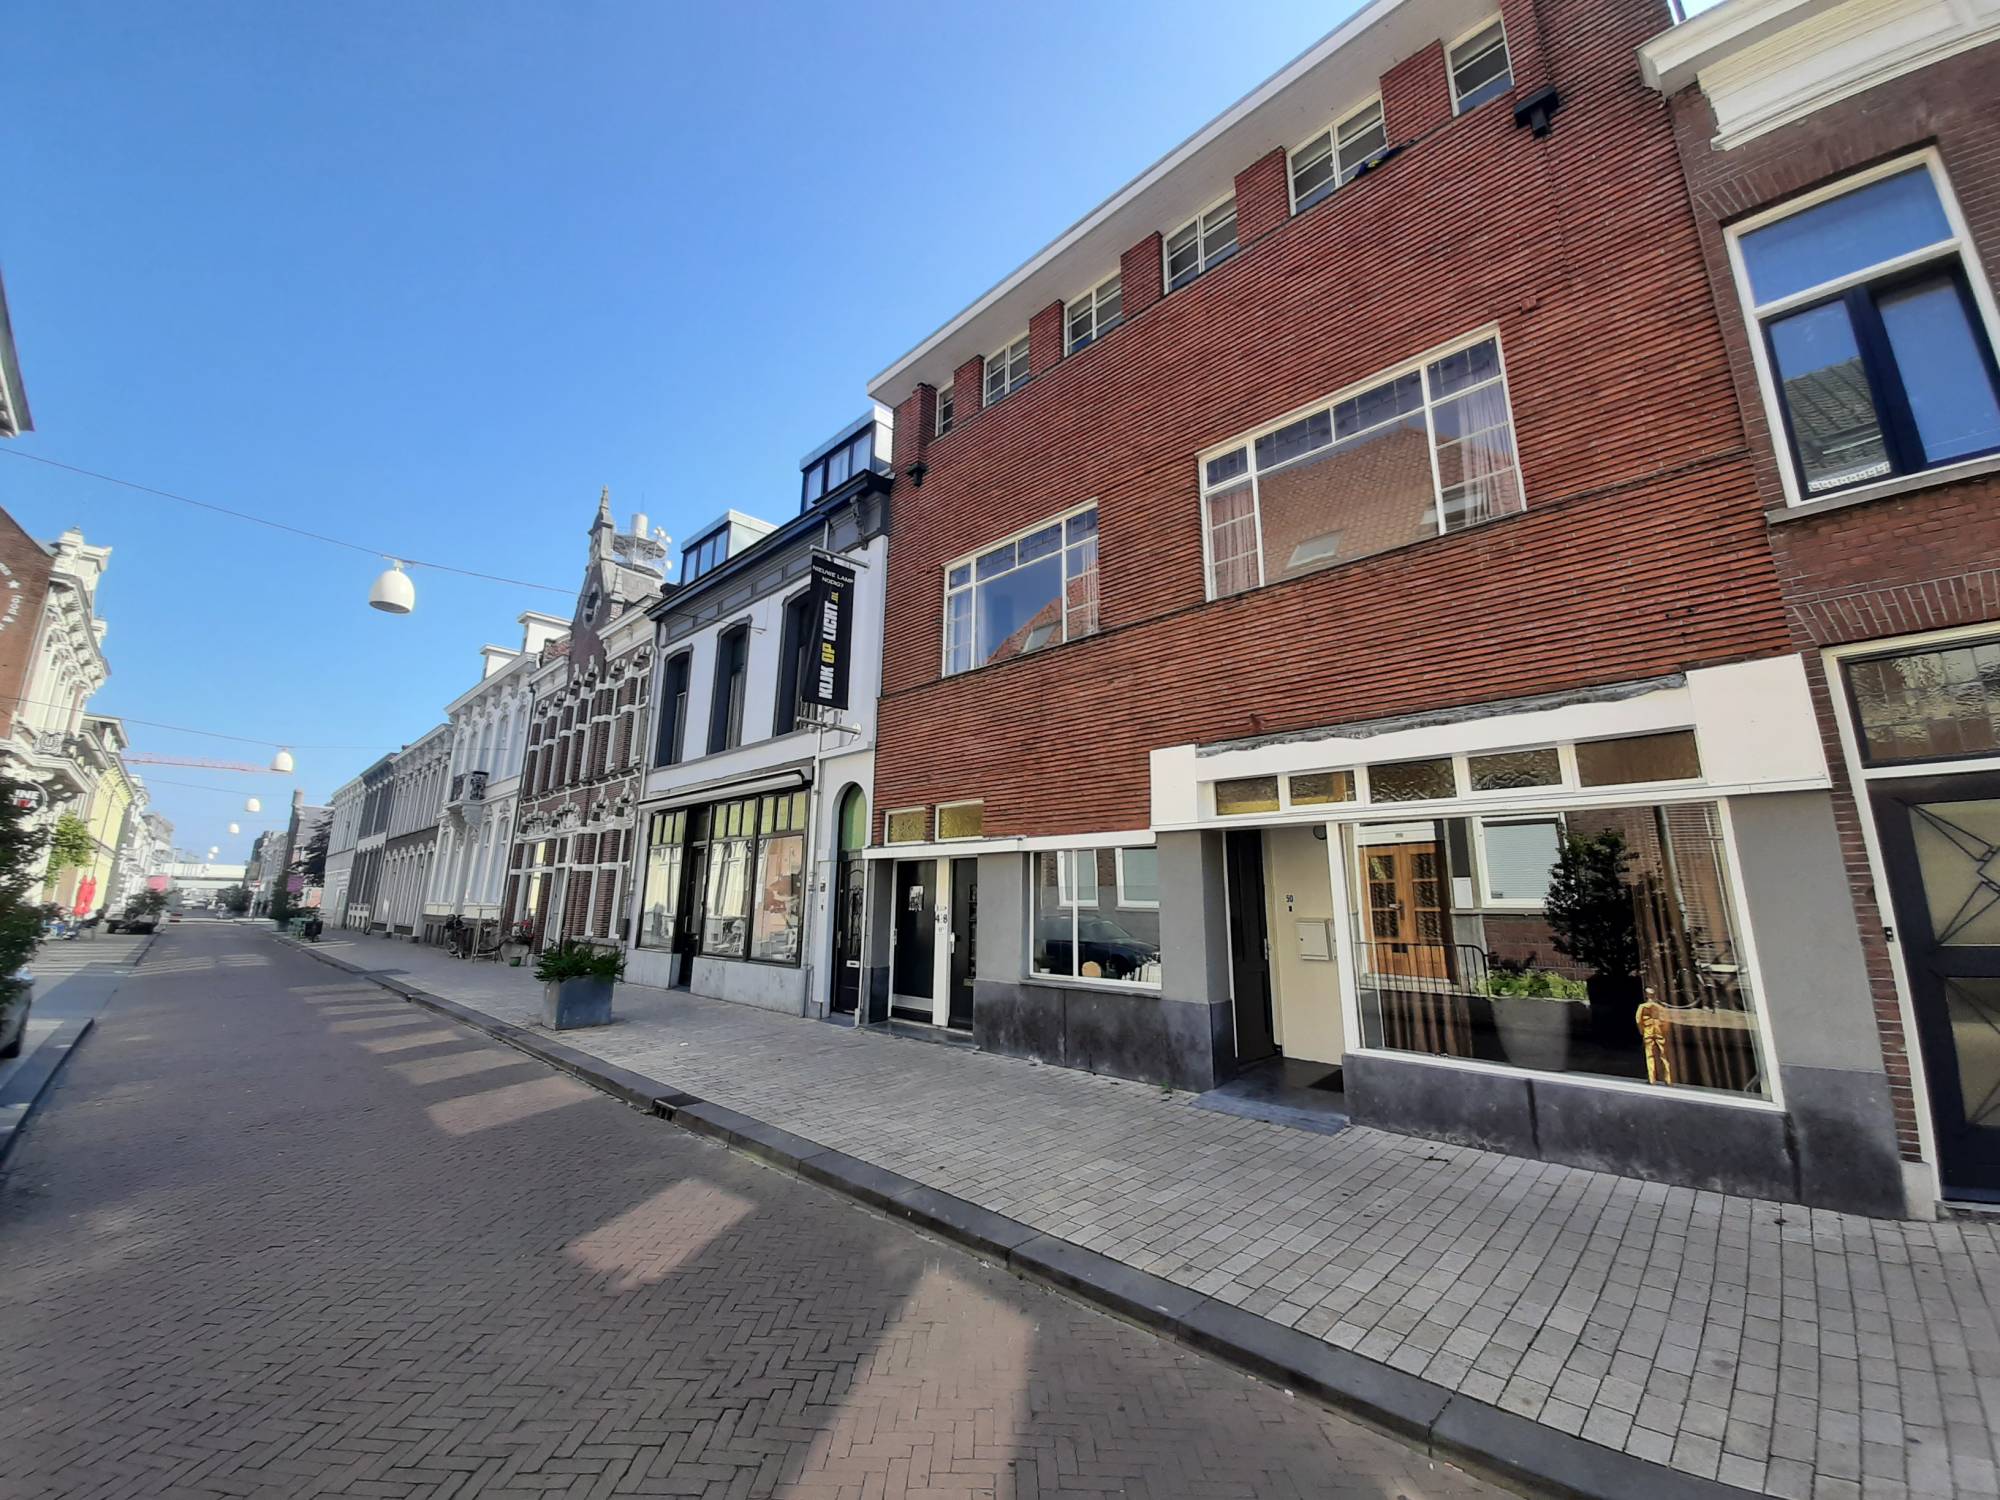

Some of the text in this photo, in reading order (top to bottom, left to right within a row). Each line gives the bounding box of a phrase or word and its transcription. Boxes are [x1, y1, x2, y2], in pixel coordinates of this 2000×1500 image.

[812, 564, 854, 583] NIEUWE LAMP
[822, 643, 835, 664] OP
[819, 665, 834, 699] KIJK
